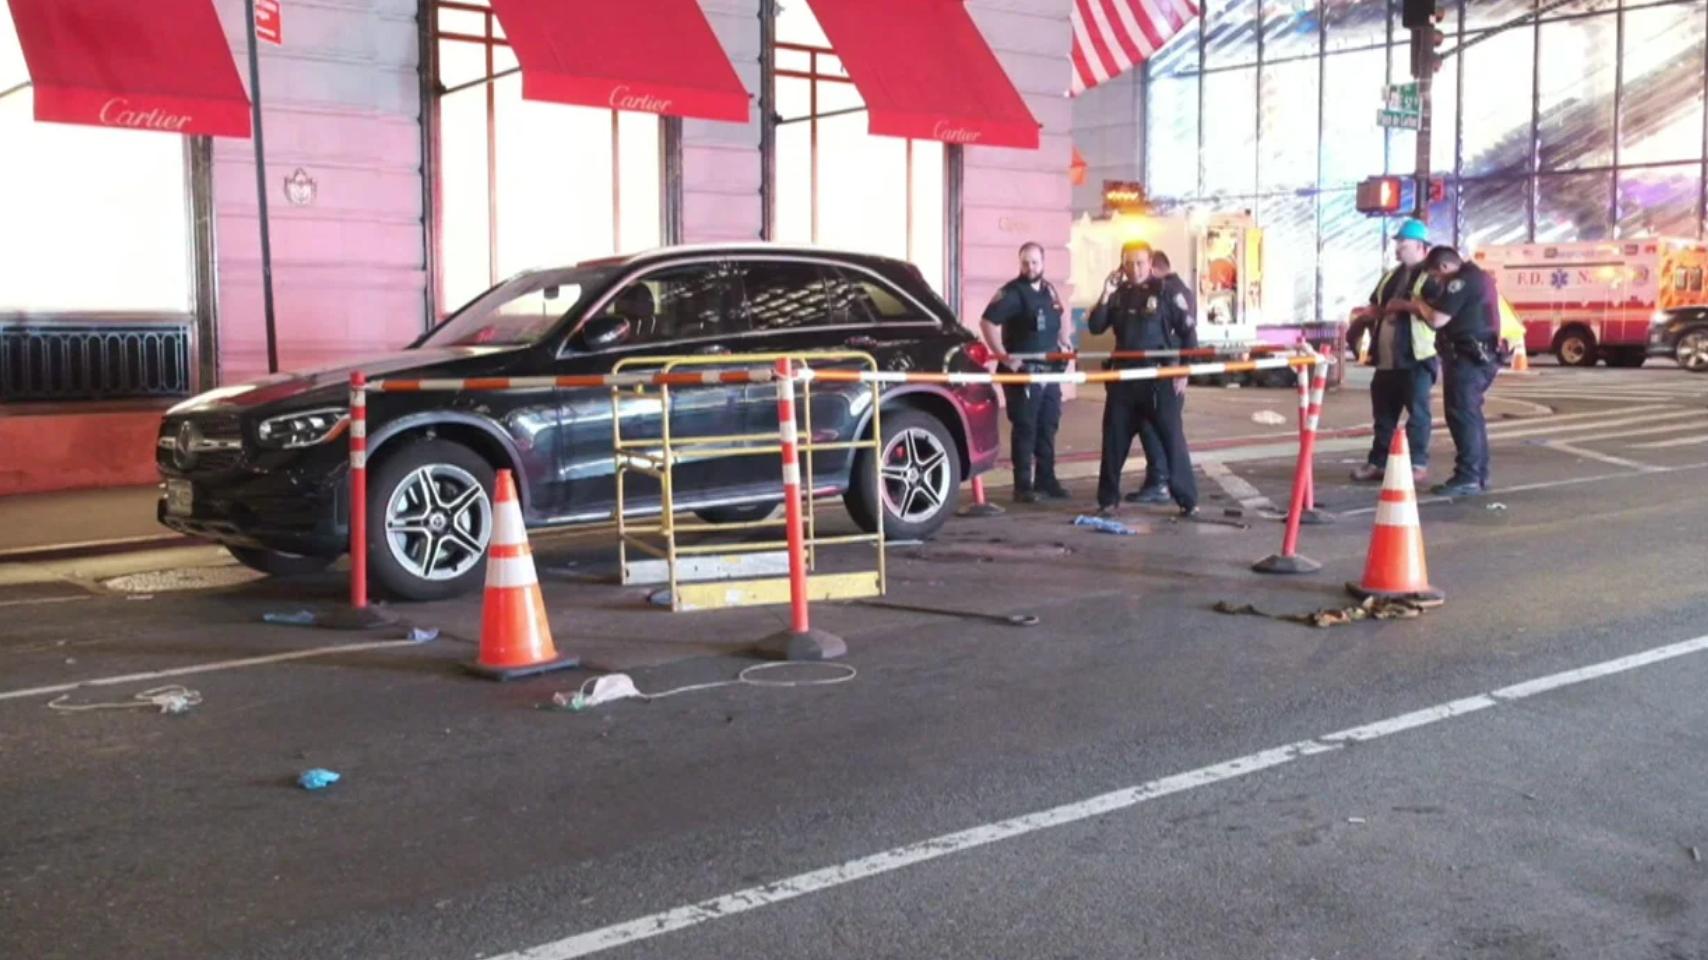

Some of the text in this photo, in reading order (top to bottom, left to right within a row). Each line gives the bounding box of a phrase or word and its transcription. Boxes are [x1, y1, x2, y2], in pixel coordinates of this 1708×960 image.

[608, 85, 672, 112] Cartier
[99, 97, 192, 129] Cartier
[933, 120, 982, 142] Cartier
